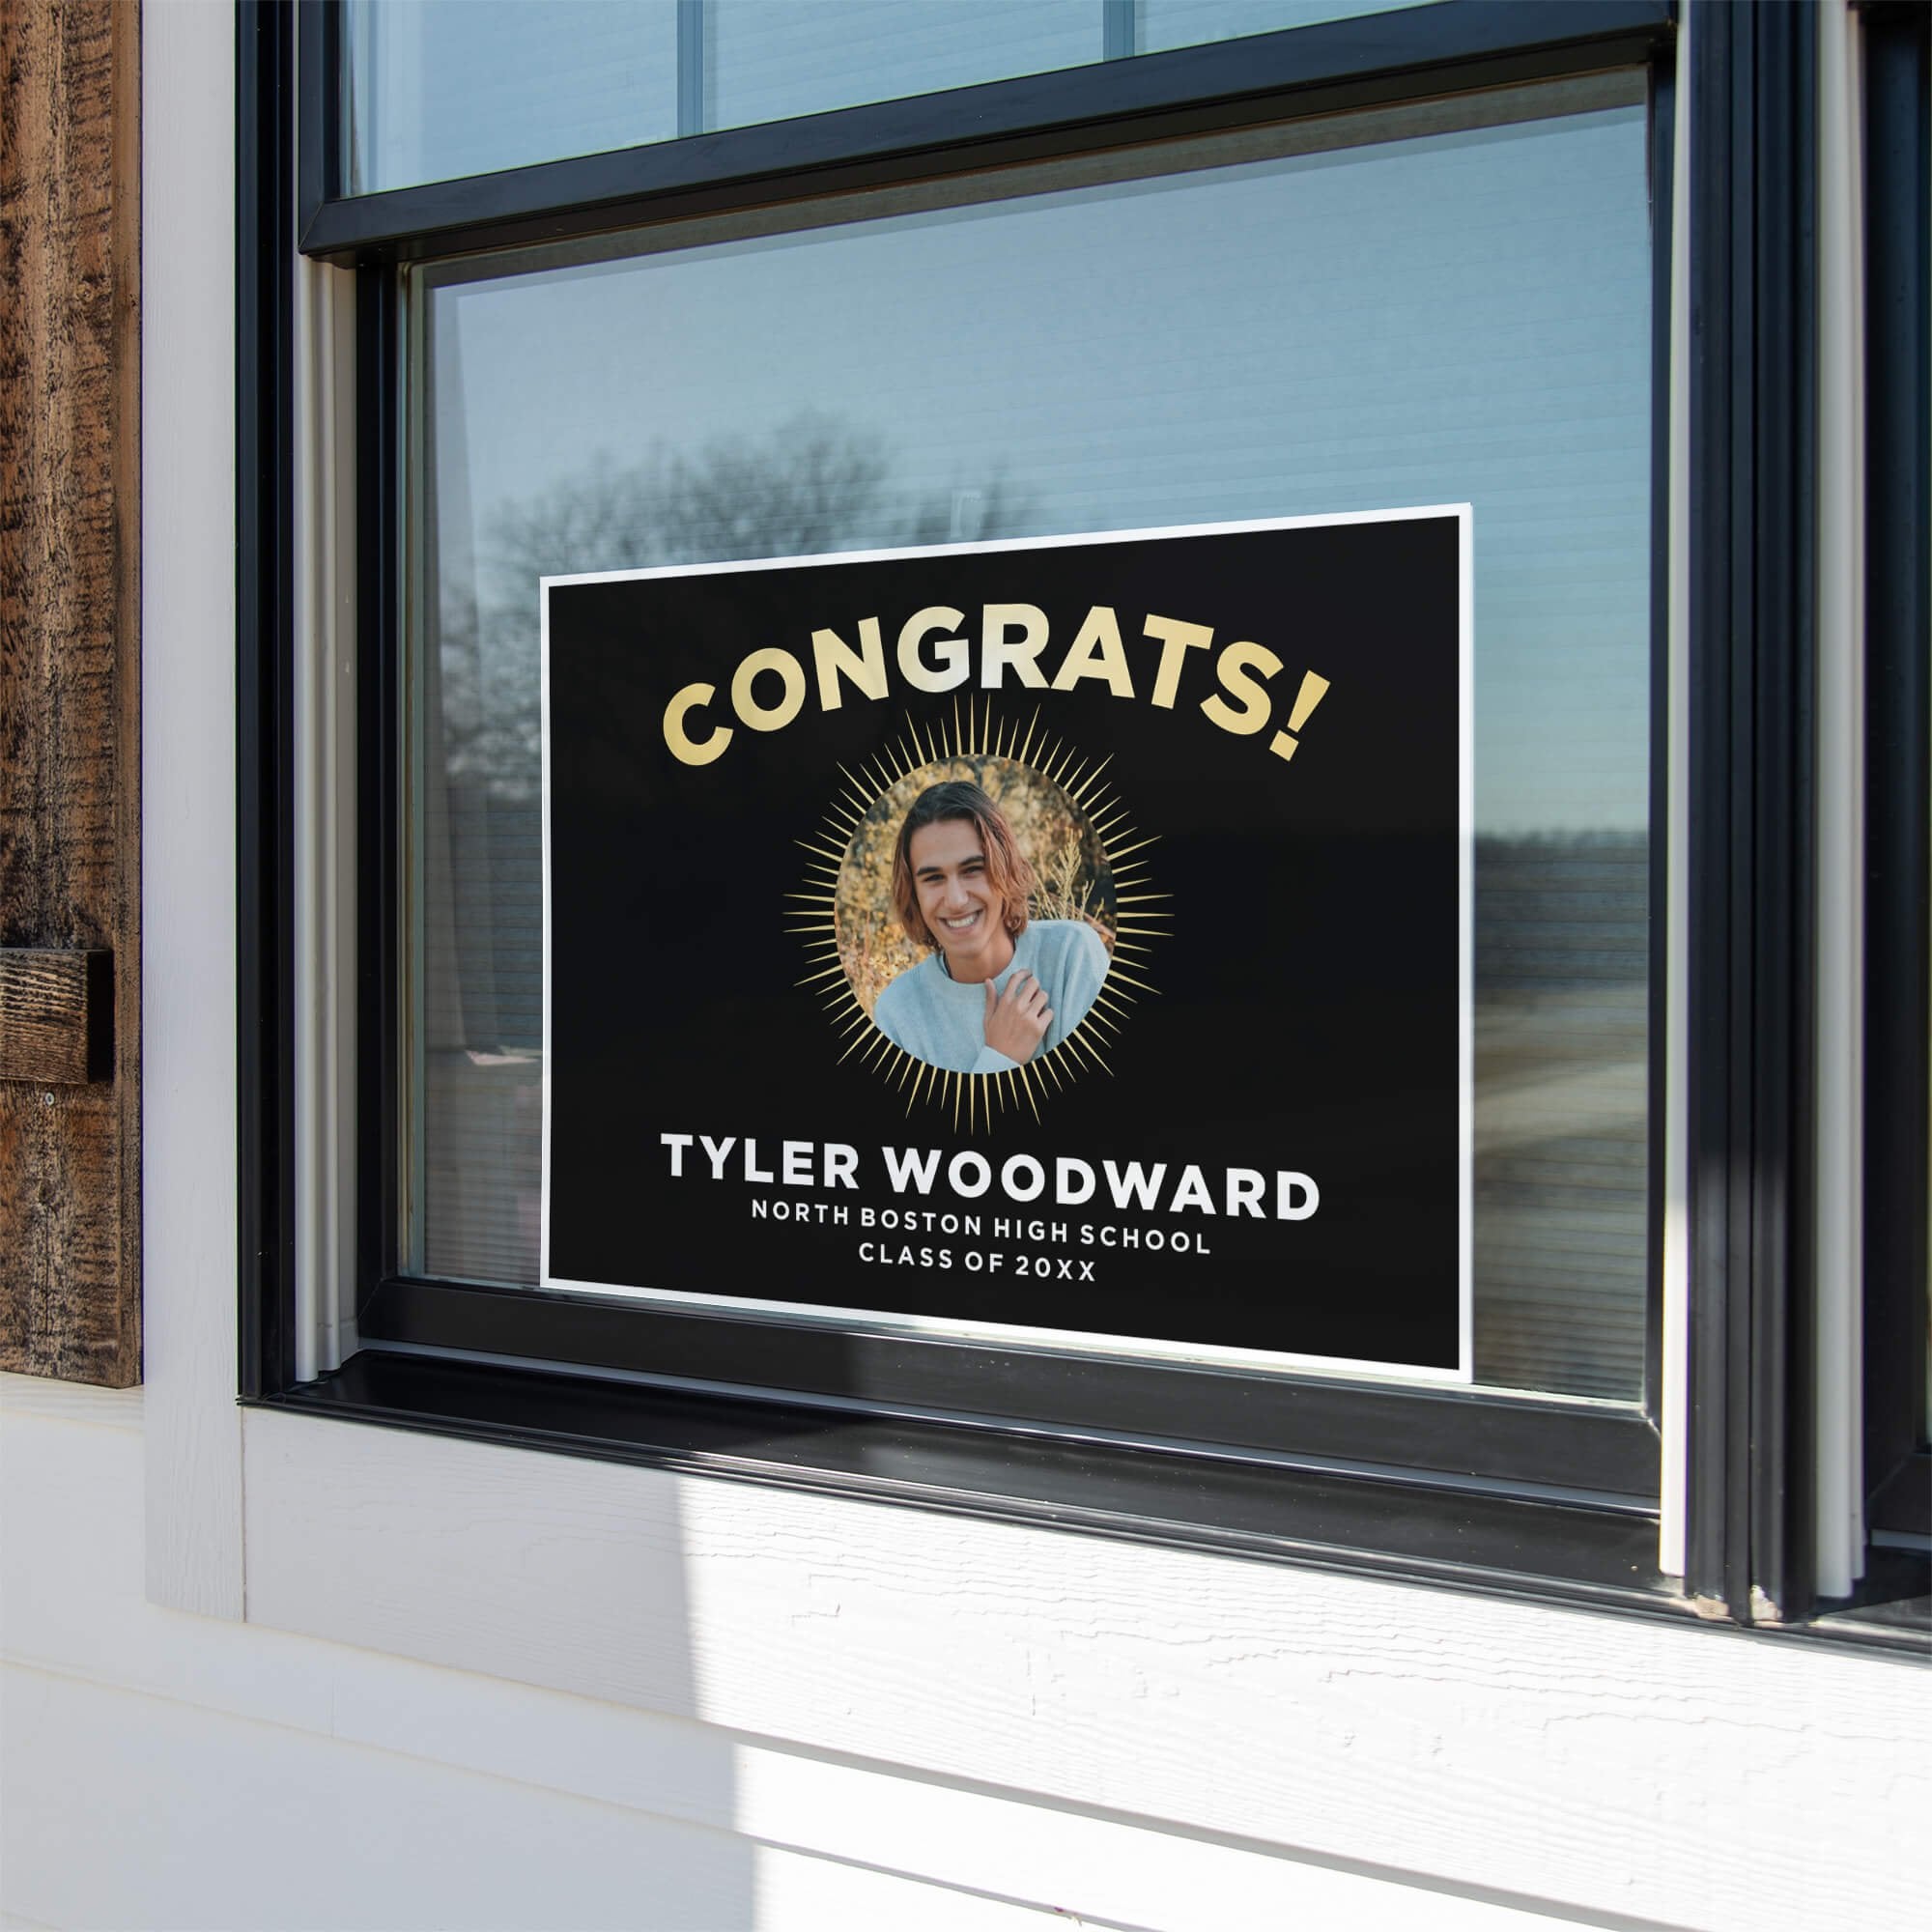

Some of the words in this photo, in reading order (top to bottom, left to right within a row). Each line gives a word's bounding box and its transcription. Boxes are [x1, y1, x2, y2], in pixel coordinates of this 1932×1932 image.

[664, 604, 1330, 766] CONGRATS!
[661, 1133, 859, 1188] TYLER
[882, 1147, 1320, 1220] WOODWARD
[753, 1200, 848, 1225] NORTH
[862, 1208, 980, 1236] BOSTON
[995, 1218, 1066, 1242] HIGH
[1081, 1225, 1209, 1254] SCHOOL
[859, 1243, 952, 1268] CLASS
[965, 1252, 1003, 1272] OF
[1016, 1256, 1094, 1281] 20XX
